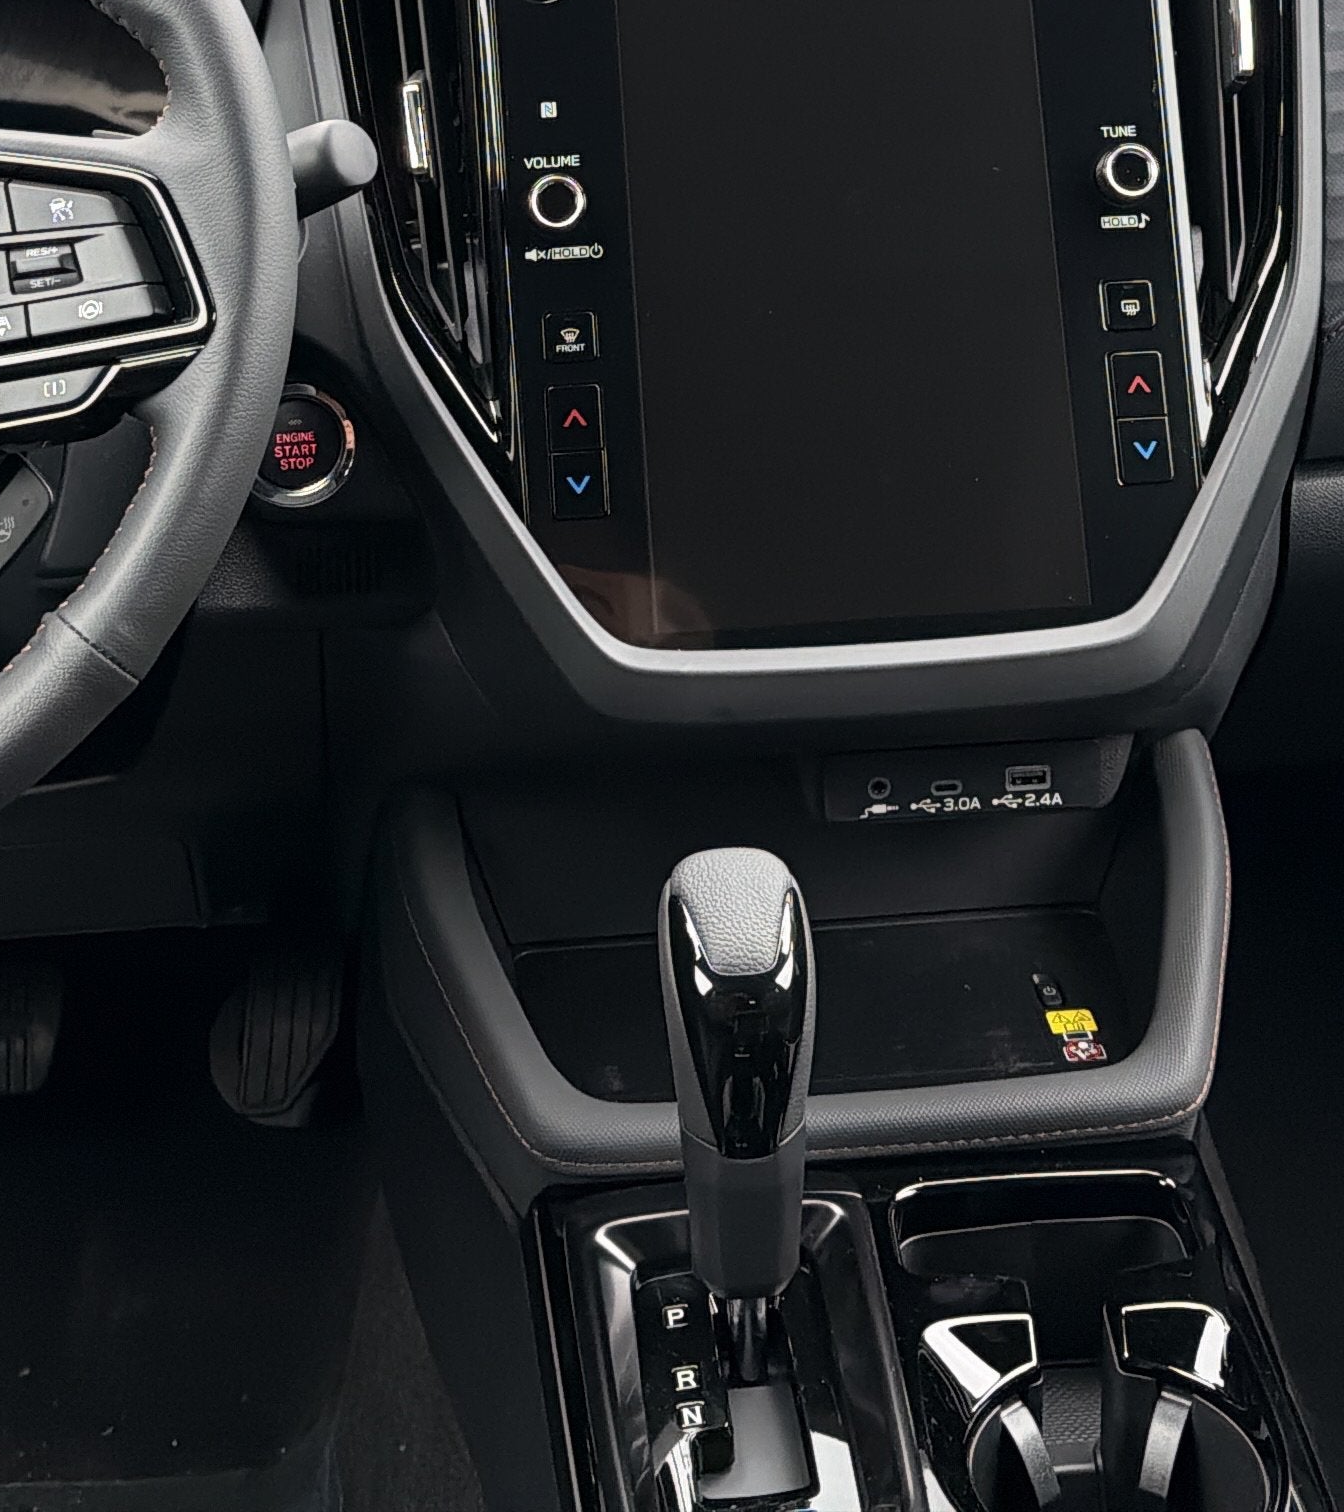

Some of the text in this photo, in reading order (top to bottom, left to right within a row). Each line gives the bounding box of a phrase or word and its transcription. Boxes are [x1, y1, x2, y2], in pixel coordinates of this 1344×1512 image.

[1100, 125, 1138, 138] TUNE
[523, 154, 581, 170] VOLUME
[1102, 216, 1137, 227] HOLD
[552, 248, 589, 258] HOLD
[555, 343, 586, 353] FRONT
[276, 430, 316, 444] ENGINE
[274, 444, 317, 458] START
[280, 457, 315, 471] STOP
[943, 797, 982, 811] 3.0A
[1024, 792, 1063, 807] 2.4A
[667, 1307, 685, 1327] P
[676, 1369, 697, 1389] R
[681, 1405, 703, 1426] N
